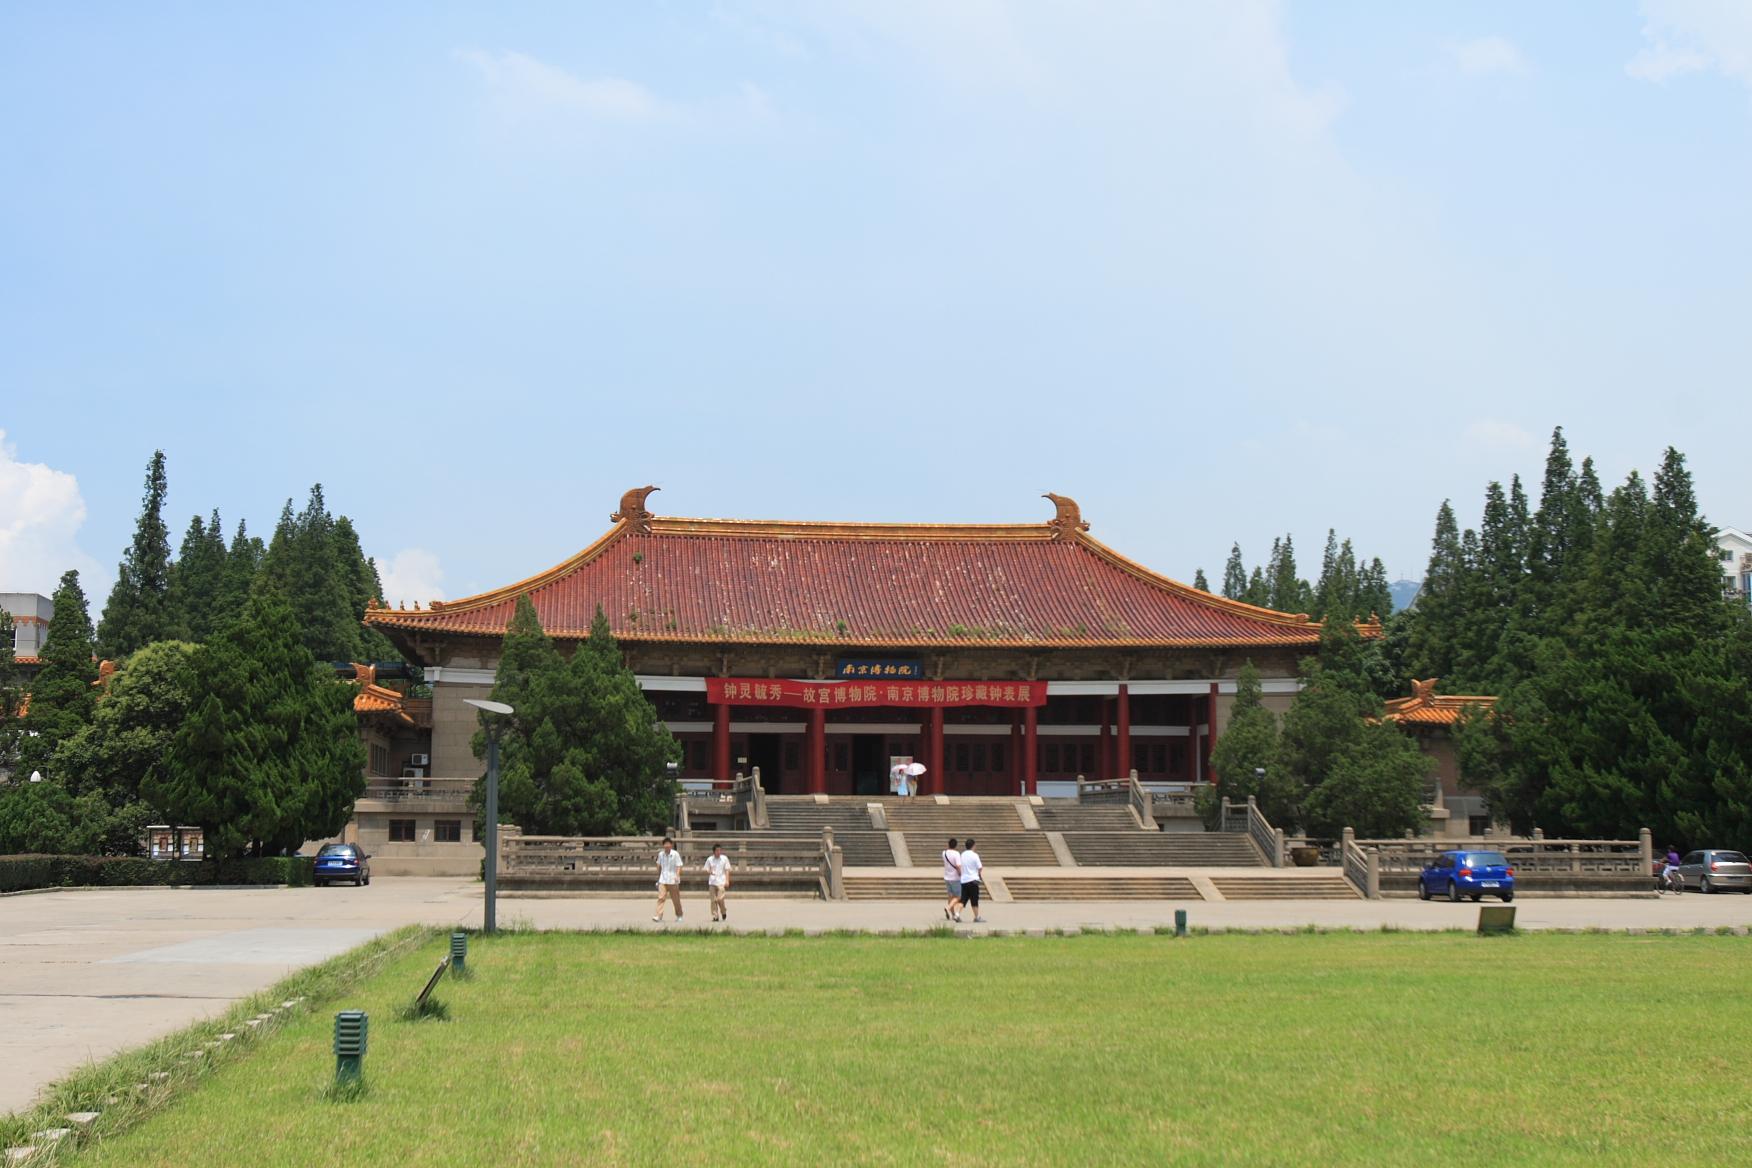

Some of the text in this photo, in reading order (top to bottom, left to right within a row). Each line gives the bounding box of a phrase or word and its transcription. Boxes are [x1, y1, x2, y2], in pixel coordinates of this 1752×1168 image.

[842, 663, 912, 676] 南京博物院
